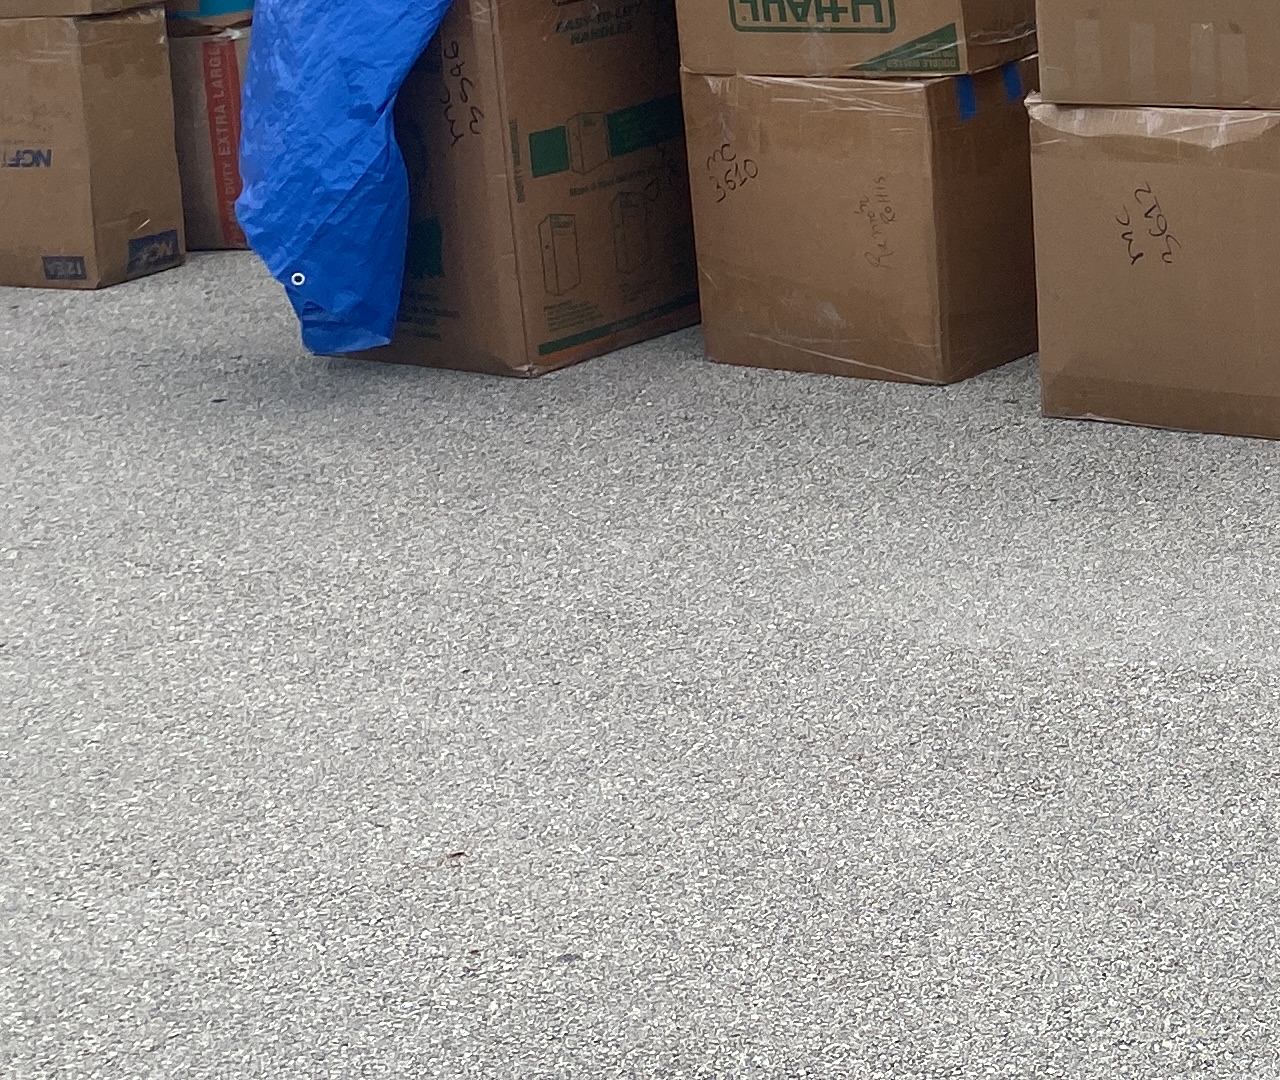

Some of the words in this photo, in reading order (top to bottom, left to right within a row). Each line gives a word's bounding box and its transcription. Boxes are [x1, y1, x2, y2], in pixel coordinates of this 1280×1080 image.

[209, 43, 224, 99] LARGE
[215, 104, 232, 156] EXTRA
[222, 163, 236, 195] DUTY
[714, 159, 759, 203] 3610
[1134, 183, 1181, 263] 3612
